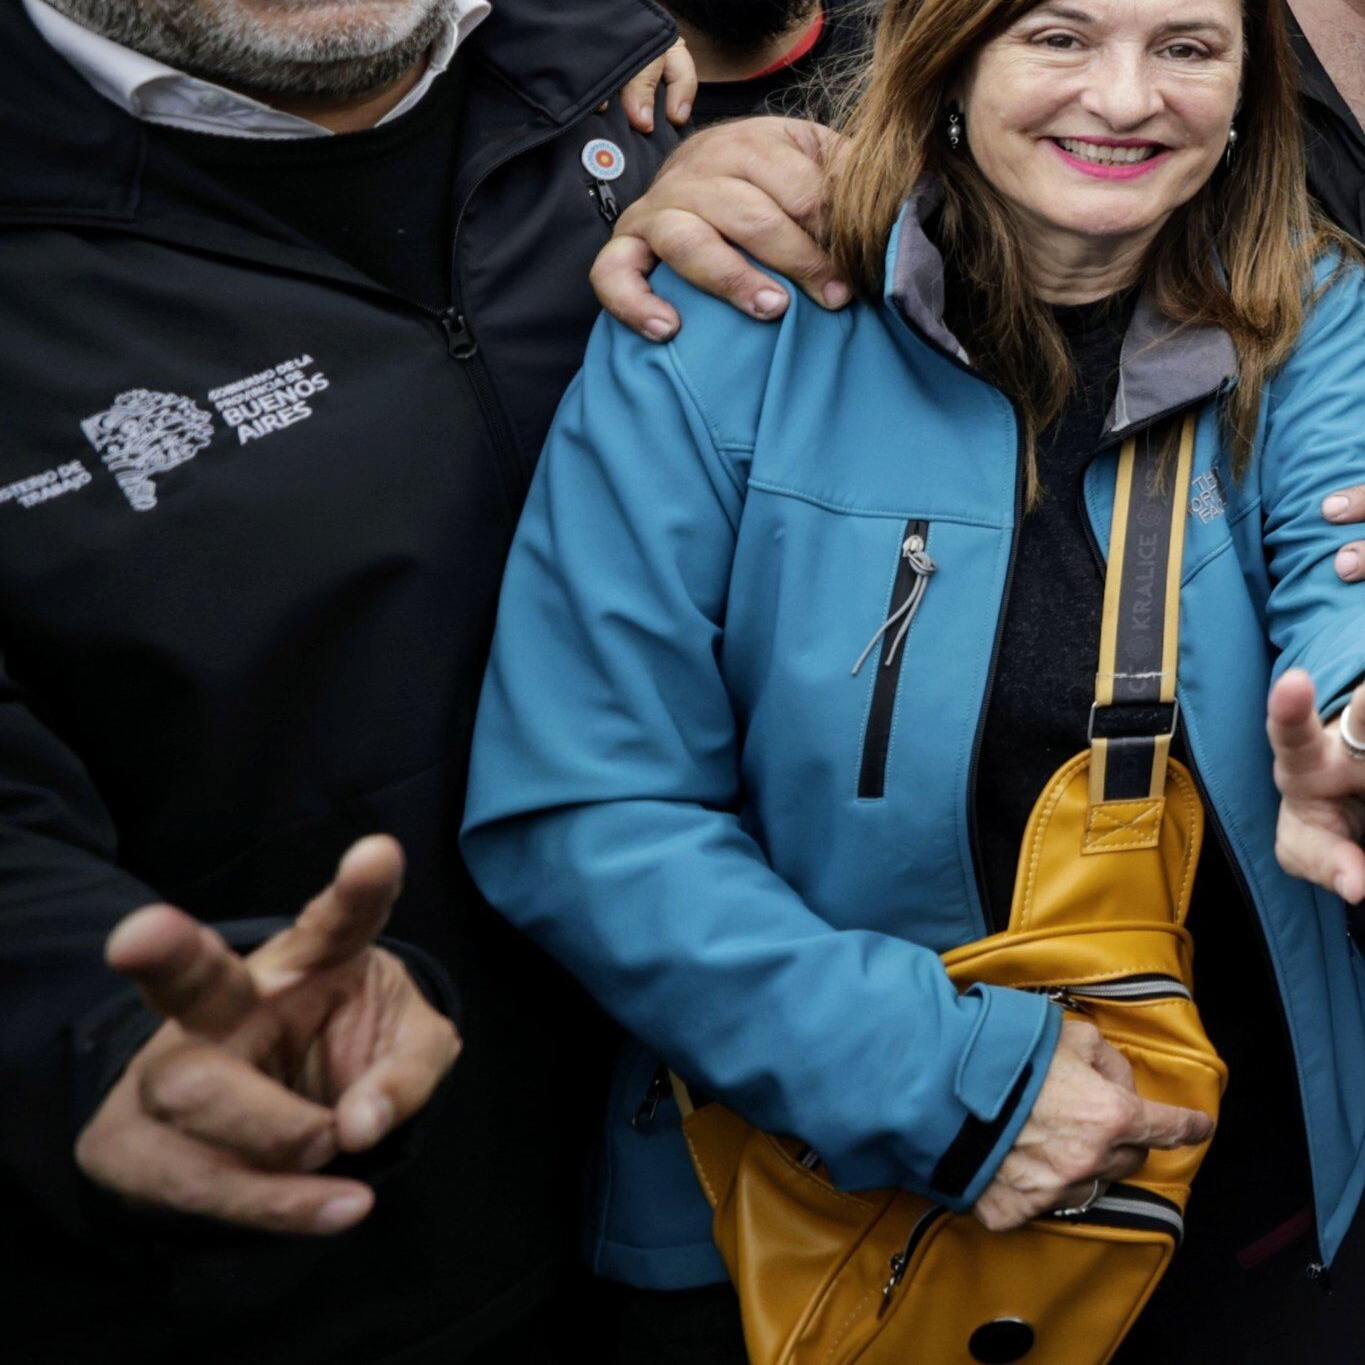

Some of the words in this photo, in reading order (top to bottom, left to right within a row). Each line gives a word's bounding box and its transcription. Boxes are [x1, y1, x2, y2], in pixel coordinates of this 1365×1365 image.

[295, 353, 315, 368] LA
[220, 372, 331, 428] BUENOS
[236, 400, 313, 447] AIRES
[1129, 532, 1159, 631] KRALICE
